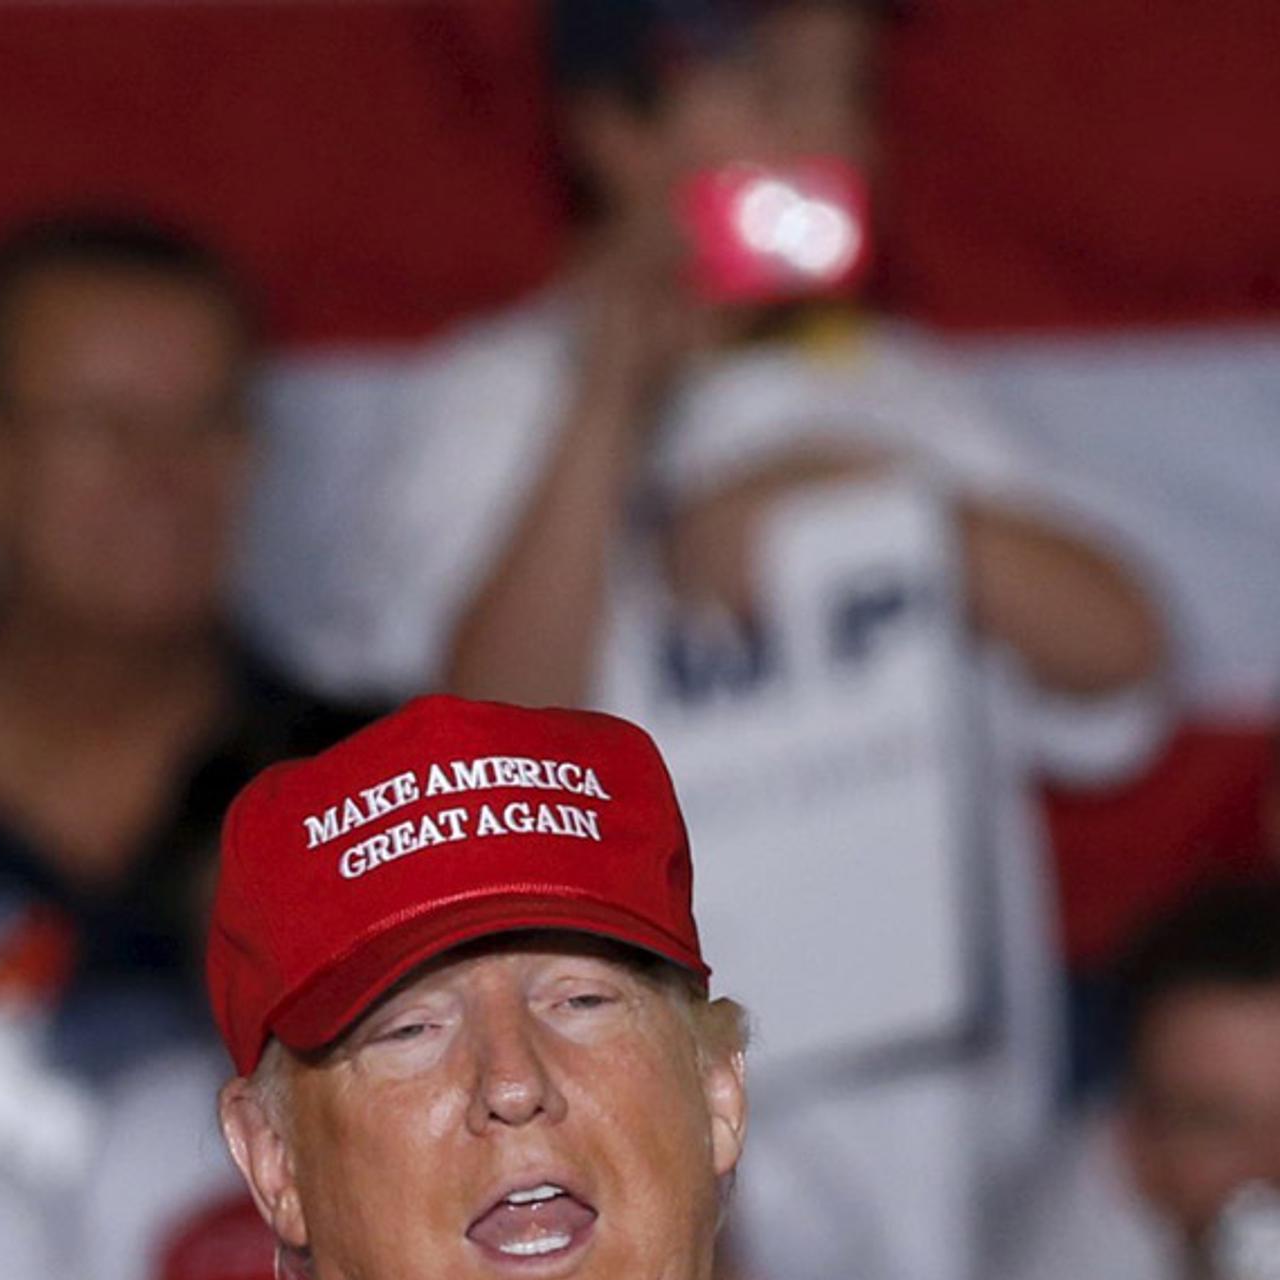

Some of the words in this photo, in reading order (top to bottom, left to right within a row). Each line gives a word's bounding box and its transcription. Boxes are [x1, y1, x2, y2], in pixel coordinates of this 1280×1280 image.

[303, 770, 422, 850] MAKE
[423, 755, 611, 801] AMERICA
[338, 807, 469, 879] GREAT
[476, 801, 603, 842] AGAIN
